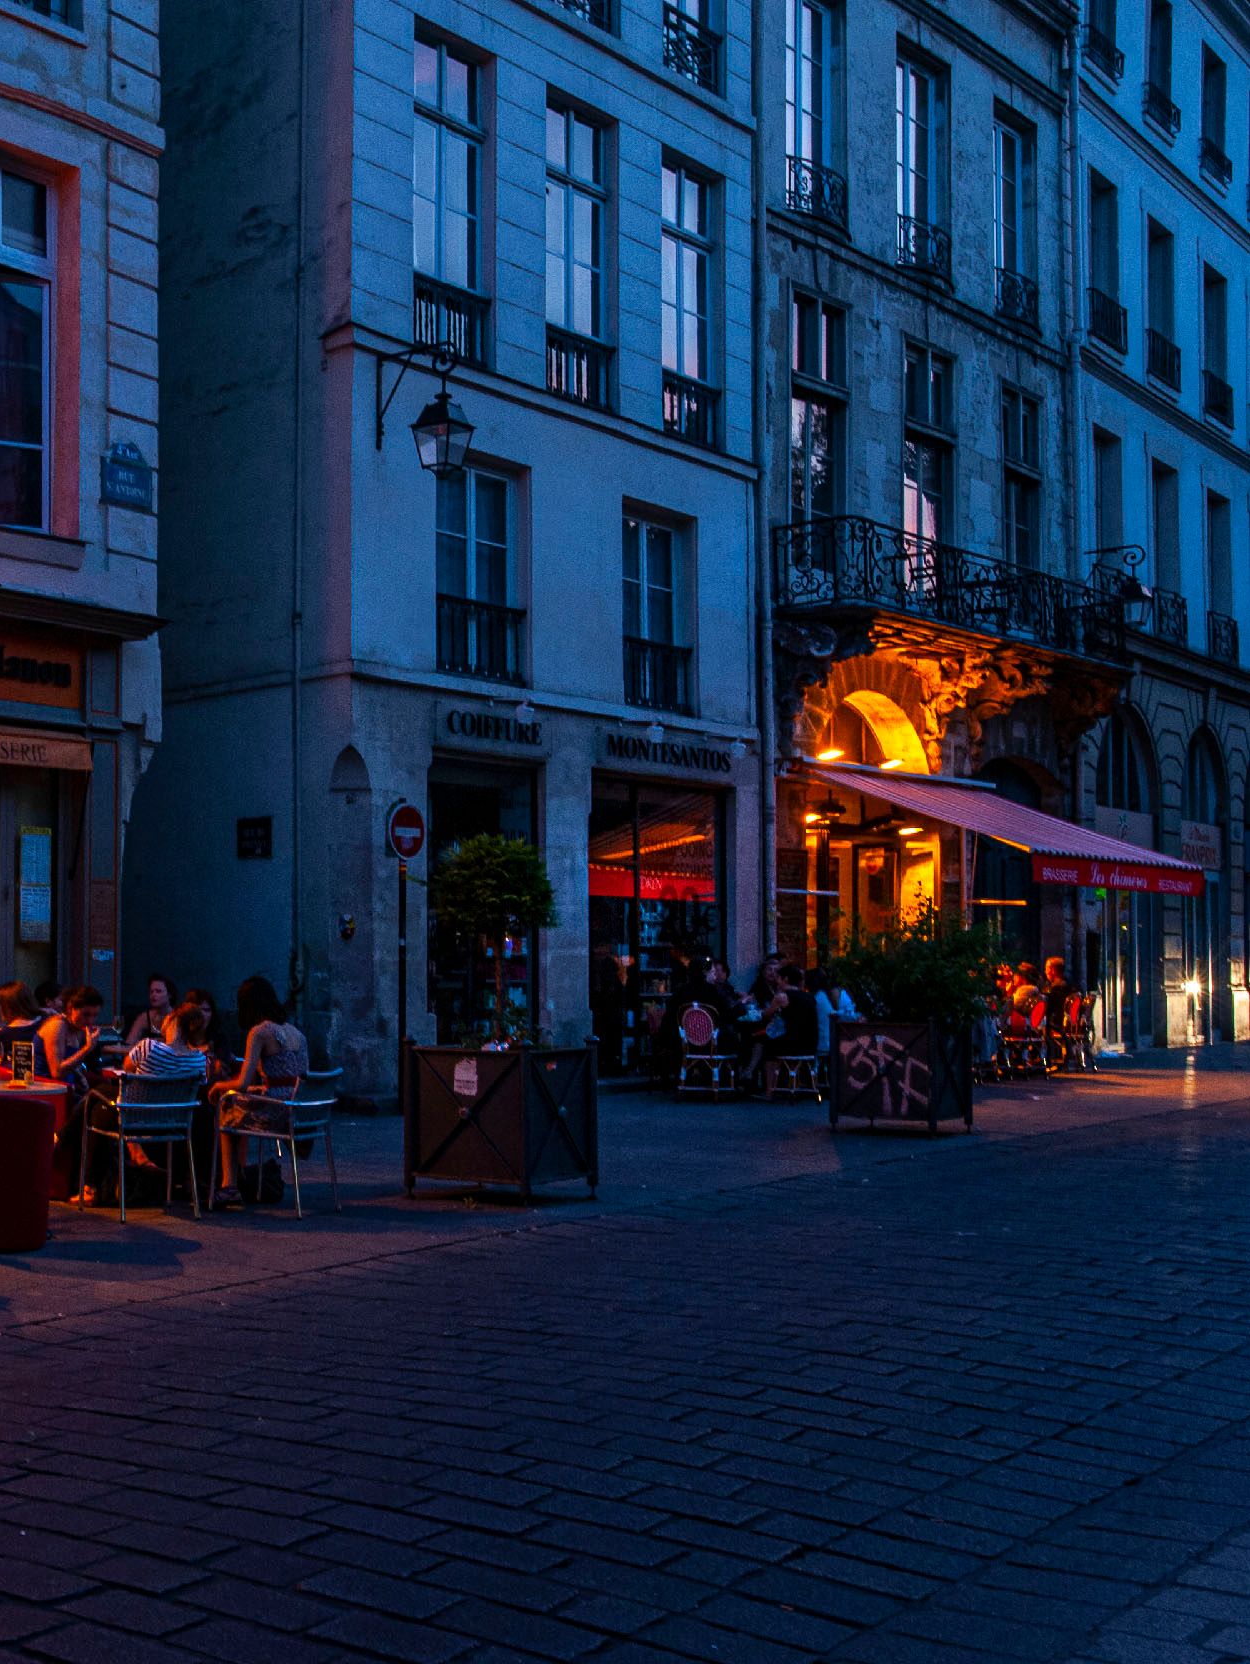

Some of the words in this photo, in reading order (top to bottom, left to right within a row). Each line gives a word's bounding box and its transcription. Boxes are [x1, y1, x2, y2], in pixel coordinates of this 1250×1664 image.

[445, 710, 543, 746] COIFFURE
[606, 733, 731, 773] MONTESANTOS
[1041, 866, 1079, 883] BRASSERIE
[1159, 878, 1195, 893] RESTAURANT
